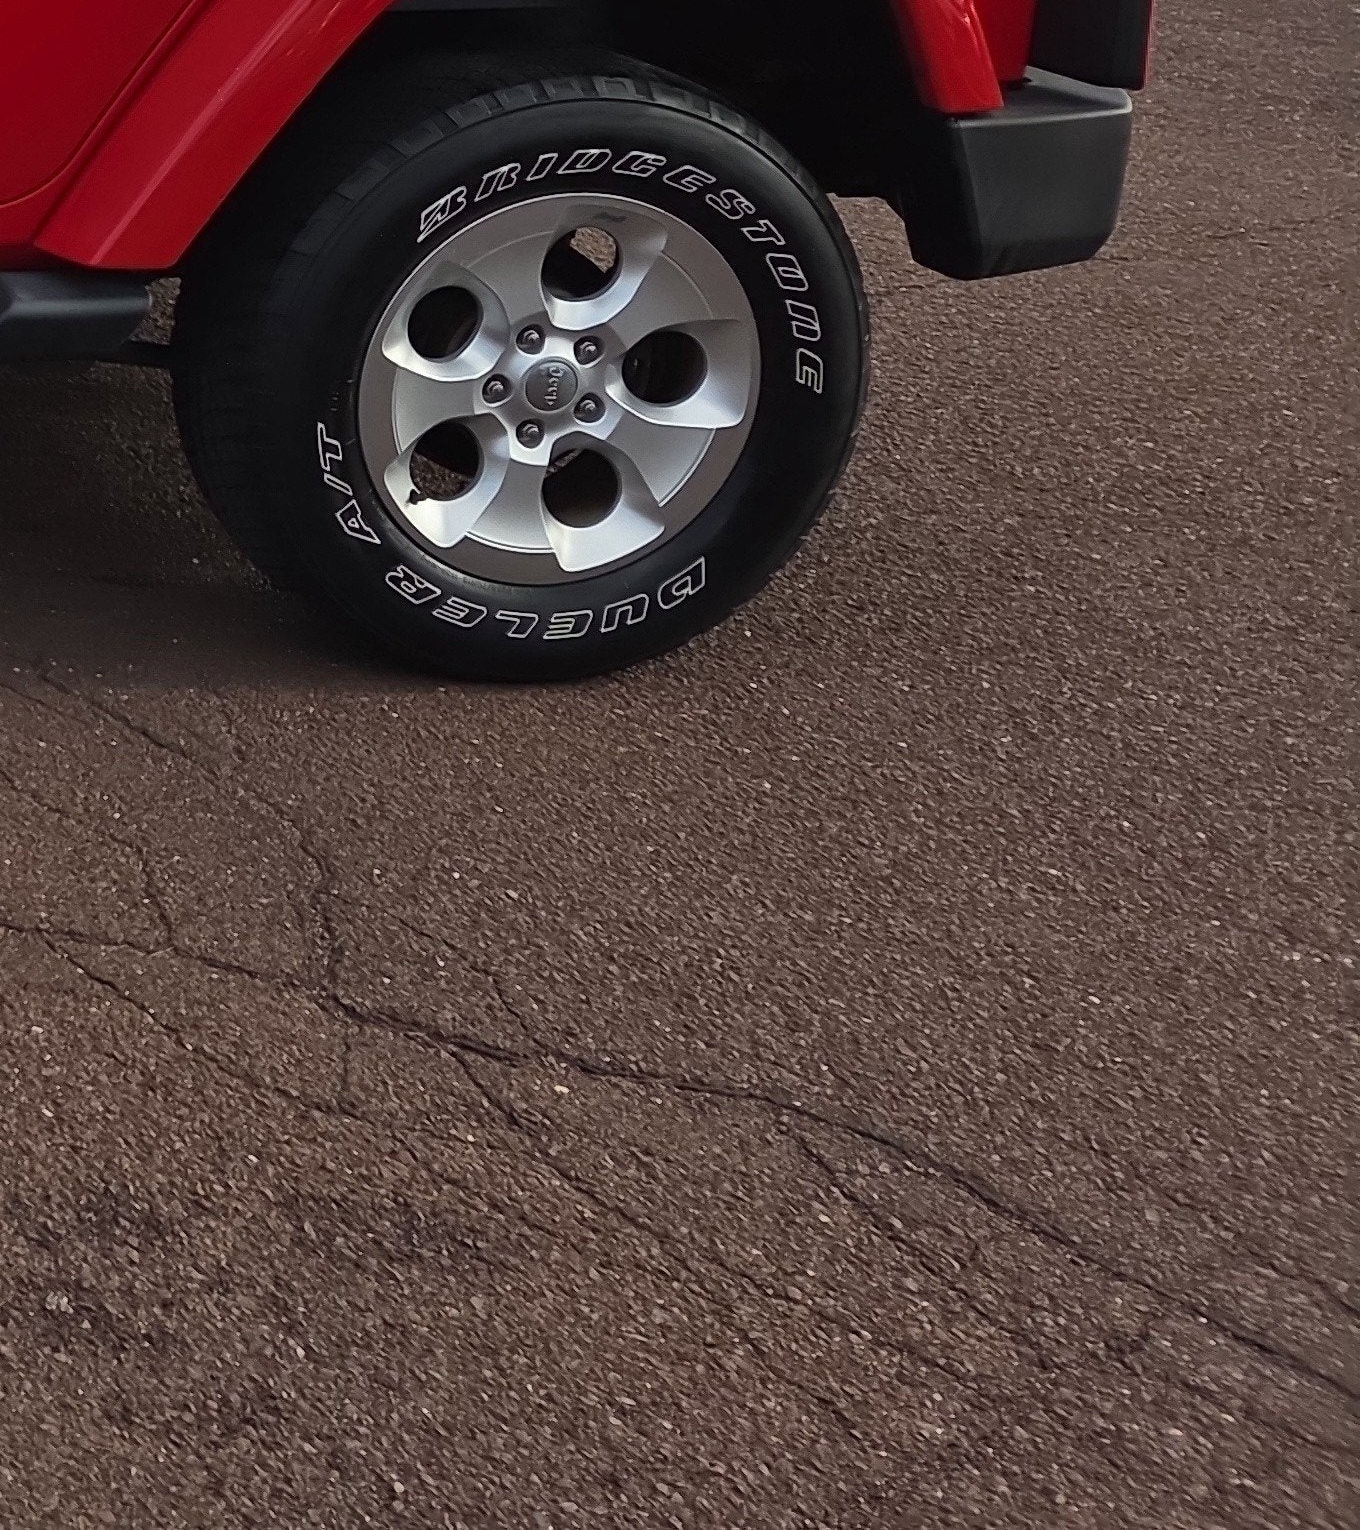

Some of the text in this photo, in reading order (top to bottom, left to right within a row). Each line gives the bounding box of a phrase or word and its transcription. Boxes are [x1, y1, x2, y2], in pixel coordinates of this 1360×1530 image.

[416, 148, 825, 394] BRIDGESTONE
[317, 422, 707, 640] DUELER A/T
